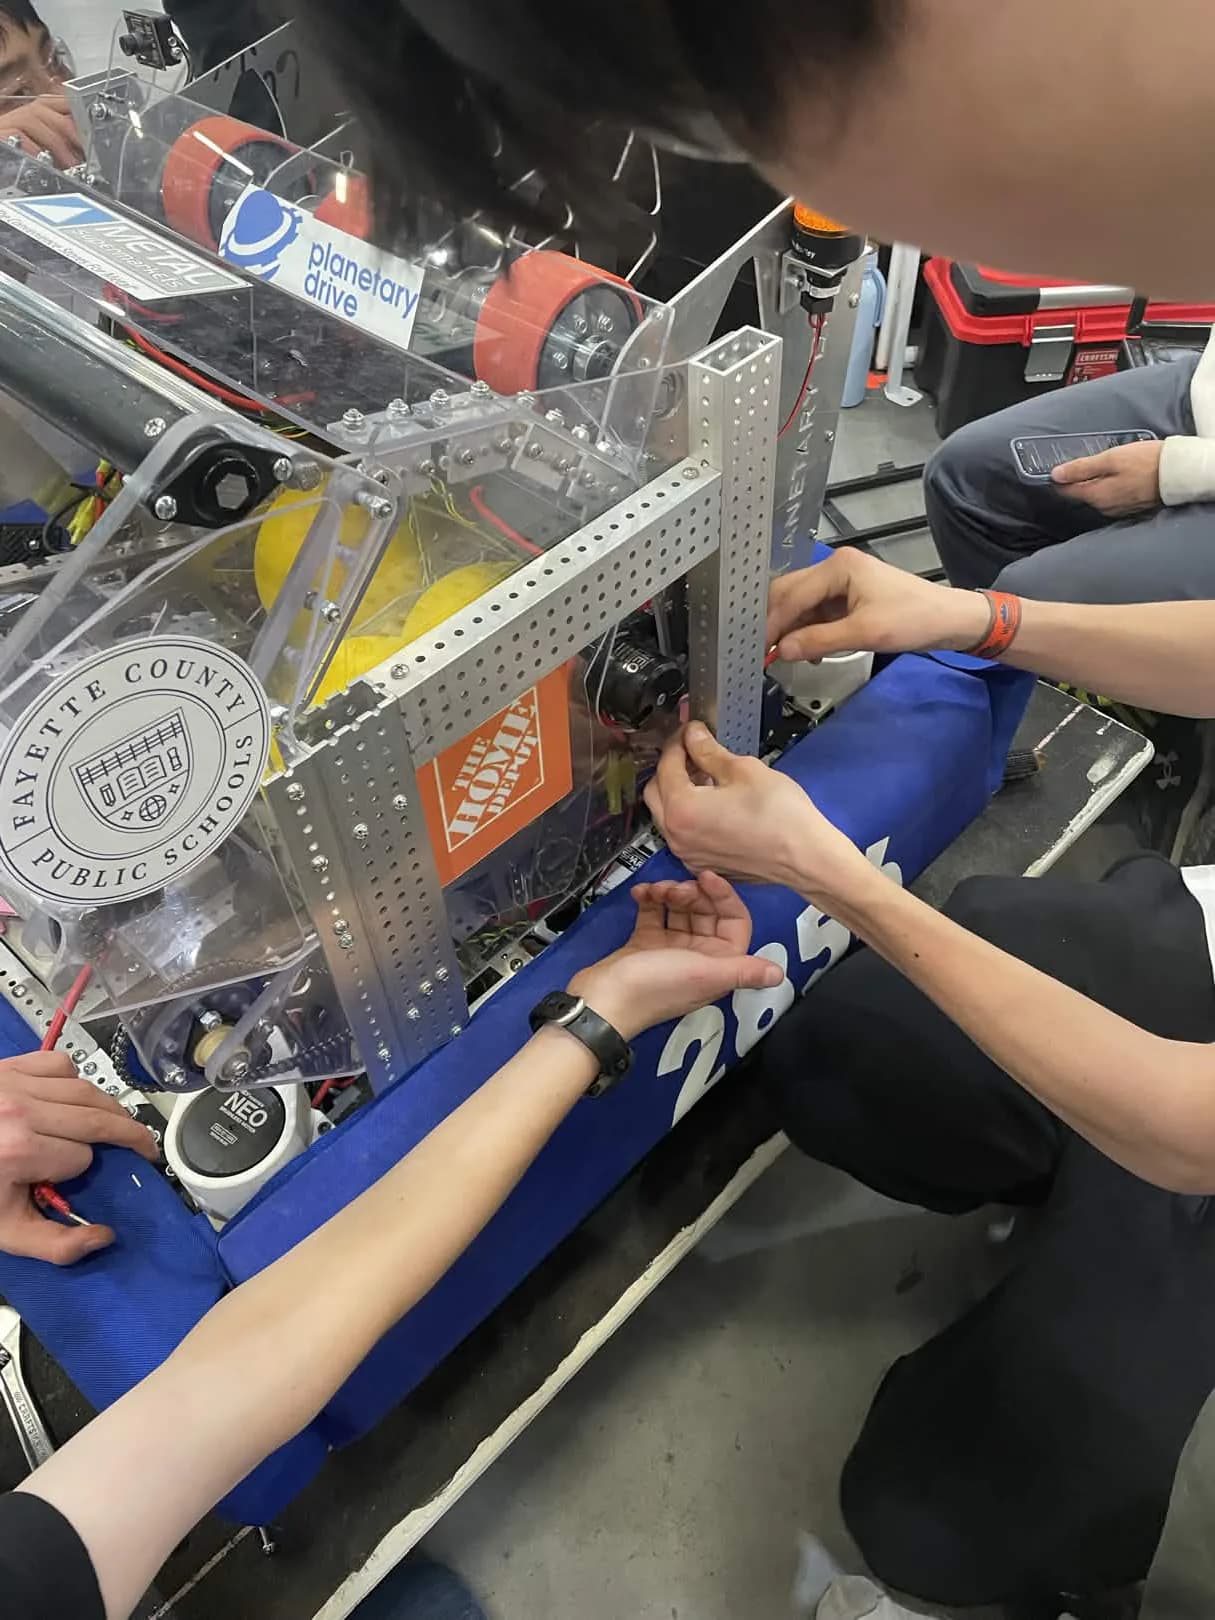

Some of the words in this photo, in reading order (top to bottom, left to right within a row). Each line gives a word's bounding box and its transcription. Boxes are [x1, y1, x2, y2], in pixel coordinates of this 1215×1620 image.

[95, 225, 216, 285] METAL
[304, 269, 358, 318] drive
[308, 241, 419, 320] planetary
[12, 679, 106, 831] FAYETTE
[125, 658, 246, 714] COUNTY
[449, 700, 537, 835] HOME
[452, 736, 491, 791] THE
[486, 730, 539, 814] DEPOT
[32, 847, 148, 888] PUBLIC
[164, 735, 253, 866] SCHOOLS
[223, 1091, 268, 1127] NEO
